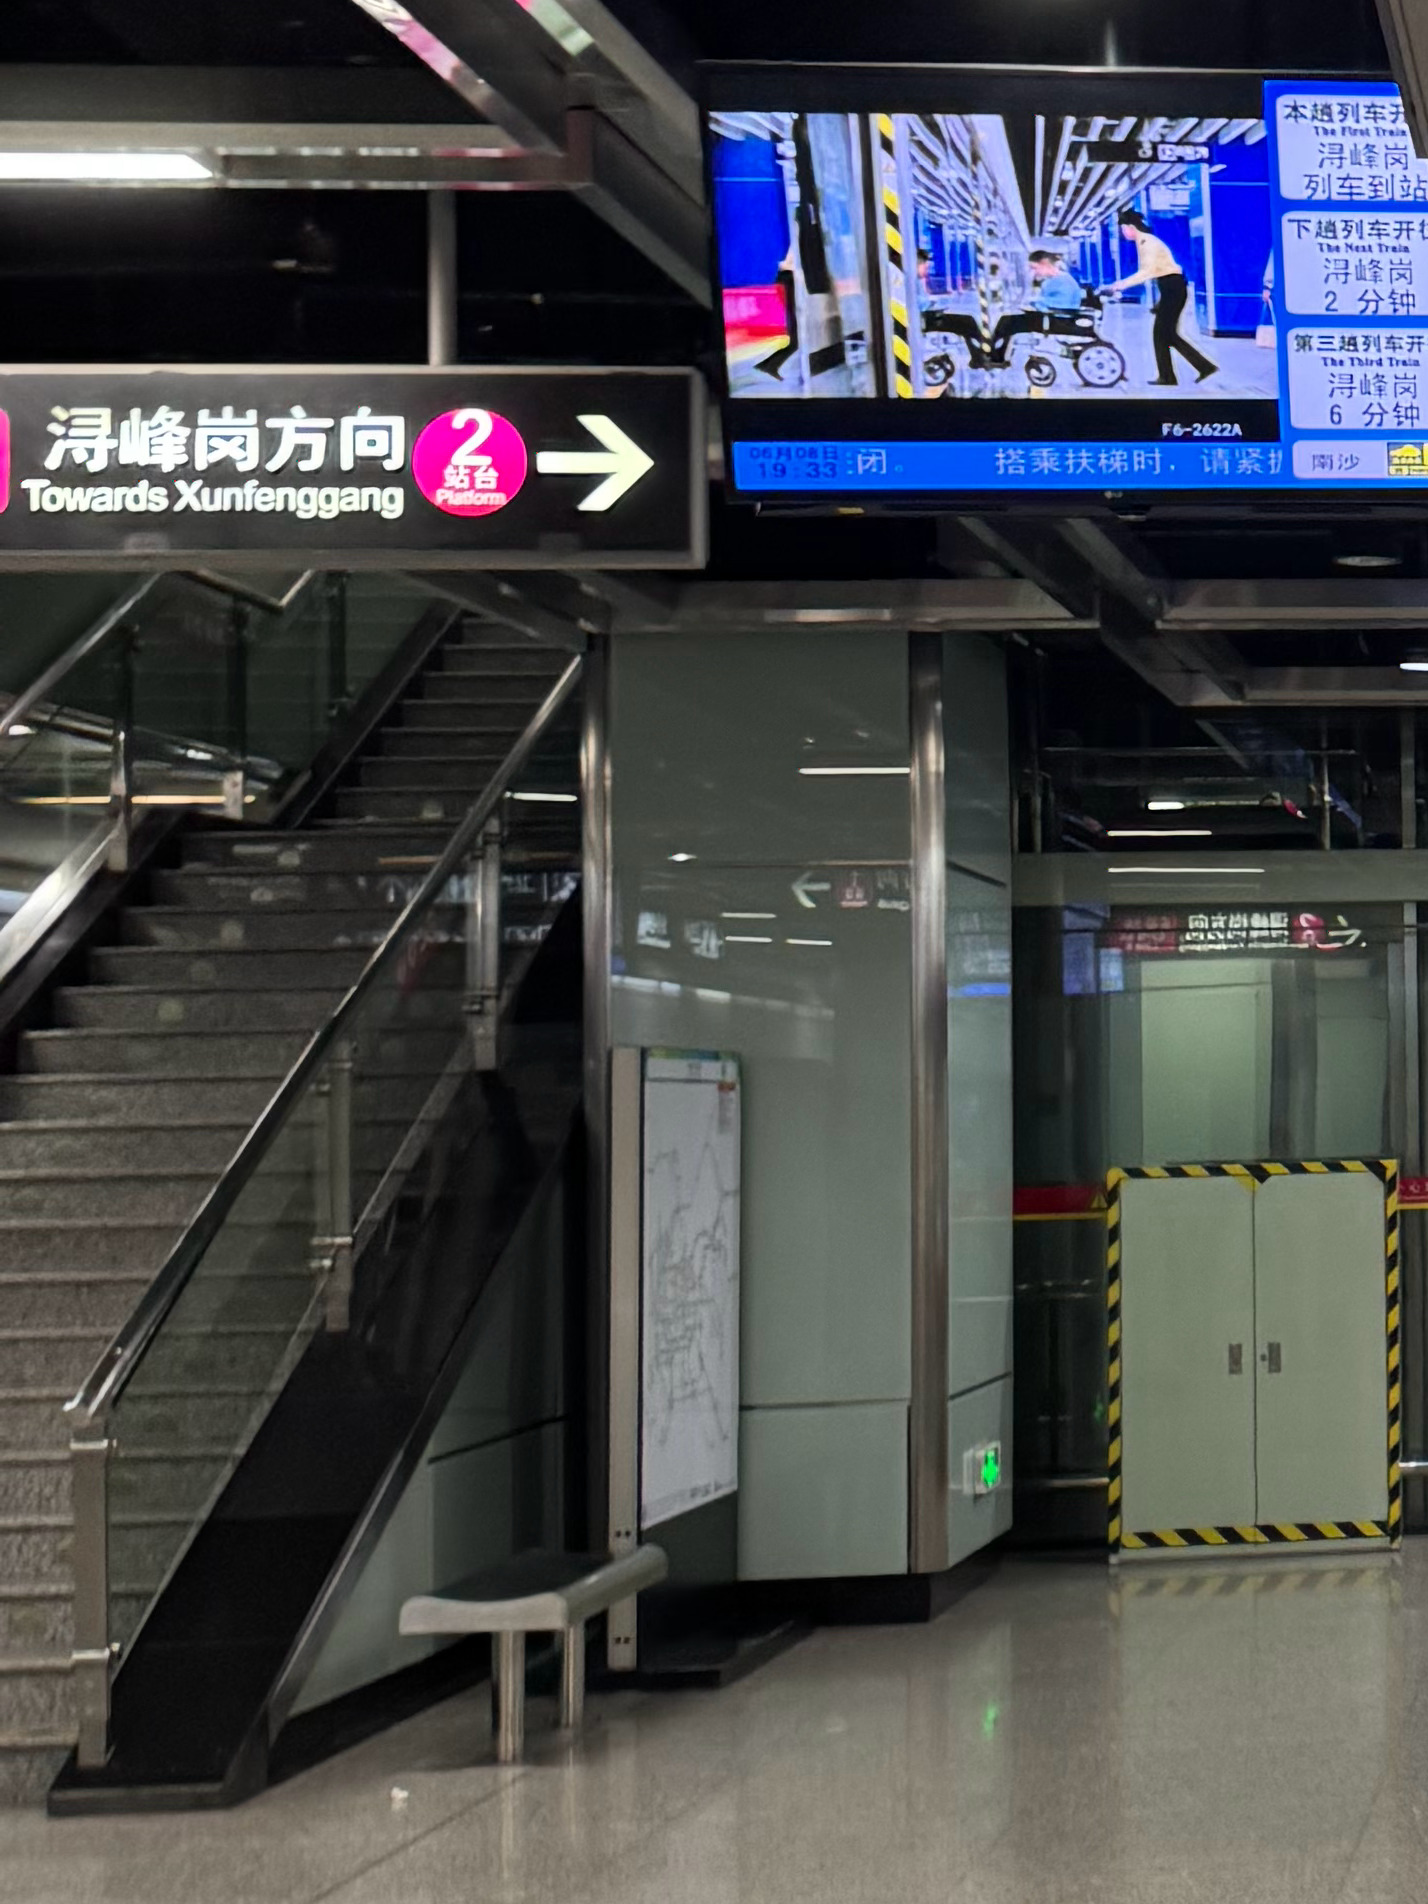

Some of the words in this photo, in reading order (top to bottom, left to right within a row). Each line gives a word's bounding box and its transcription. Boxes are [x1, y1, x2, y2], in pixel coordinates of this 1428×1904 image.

[1318, 142, 1409, 170] 浔峰岗
[1303, 173, 1428, 201] 列车到站
[1323, 257, 1414, 285] 浔峰岗
[1324, 291, 1339, 313] 2
[1357, 289, 1416, 314] 分钟
[1328, 372, 1418, 399] 浔峰岗
[1330, 405, 1343, 425] 6
[1362, 402, 1421, 427] 分钟
[44, 405, 405, 473] 浔峰岗方向
[451, 408, 493, 466] 2
[1161, 422, 1243, 437] F6-2622A
[444, 465, 499, 490] 站台
[20, 478, 169, 513] Towards
[172, 478, 405, 520] Xunfenggang
[436, 489, 507, 506] Platform
